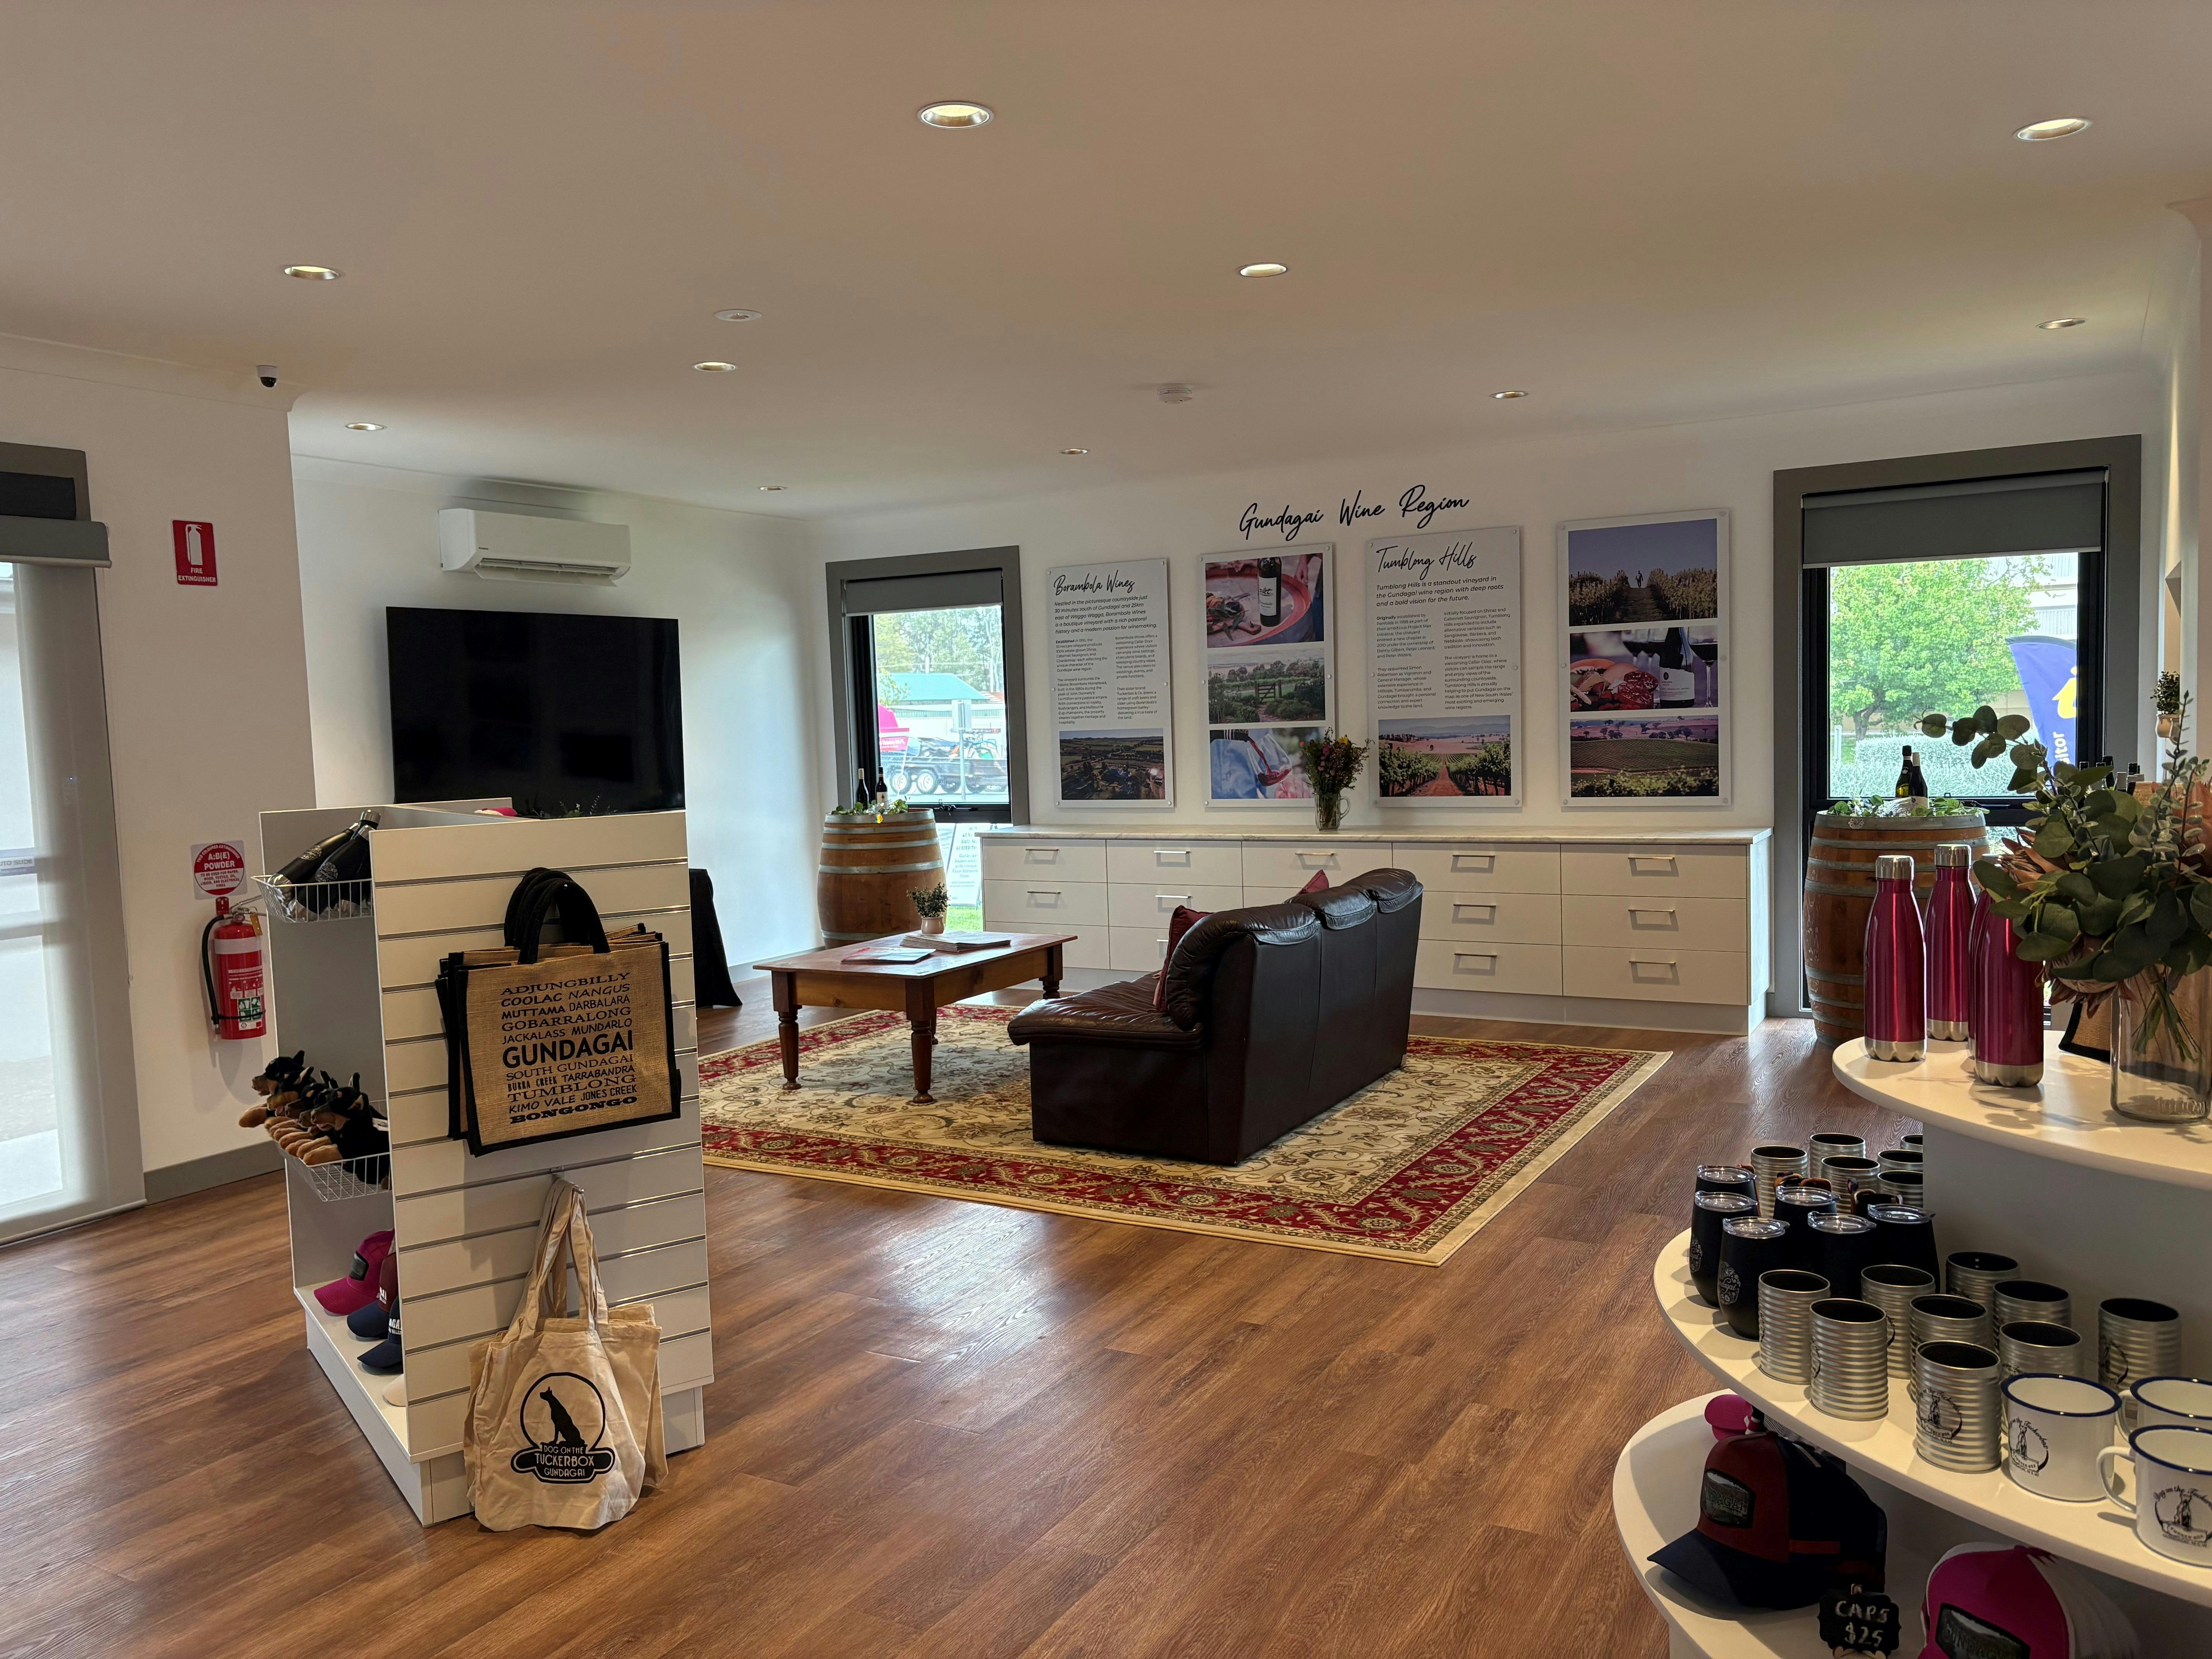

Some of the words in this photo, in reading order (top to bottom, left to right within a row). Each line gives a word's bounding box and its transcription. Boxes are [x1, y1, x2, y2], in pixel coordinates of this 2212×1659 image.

[1239, 503, 1324, 541] Gundagai
[1340, 490, 1385, 526] Wine
[1399, 484, 1470, 529] Region
[1376, 546, 1435, 580] Tumblong
[1439, 542, 1477, 571] Hills
[1054, 573, 1103, 596] Borambola
[1106, 570, 1135, 593] Wines
[1462, 576, 1489, 584] vineyard
[204, 860, 235, 870] POWDER
[208, 851, 230, 860] A:B(E)
[500, 972, 630, 995] ADJUNGBILLY
[501, 993, 563, 1007] COOLAC
[569, 984, 630, 1000] NANGUS
[501, 1005, 566, 1020] MUTTAMA
[569, 994, 630, 1012] DARBALARA
[502, 1007, 631, 1031] GOBARRALONG
[502, 1029, 566, 1044] JACKALASS
[572, 1018, 632, 1036] MUNDARLO
[502, 1030, 633, 1068] GUNDAGAI
[507, 1066, 553, 1081] SOUTH
[557, 1054, 634, 1073] GUNDAGAI
[508, 1080, 531, 1092] BURRA
[536, 1075, 557, 1087] CREEK
[562, 1065, 635, 1082] TARRABANDRA
[508, 1074, 637, 1103] TUMBLONG
[509, 1101, 540, 1114] KIMO
[544, 1095, 576, 1107] VALE
[580, 1089, 608, 1101] JONES
[610, 1084, 637, 1096] CREEK
[510, 1096, 637, 1124] BONGONGO
[534, 1453, 594, 1467] TUCKERBOX
[544, 1445, 558, 1453] DOG
[544, 1467, 585, 1477] GUNDAGAI
[1835, 1601, 1889, 1623] CAPS
[1844, 1622, 1884, 1647] $25
